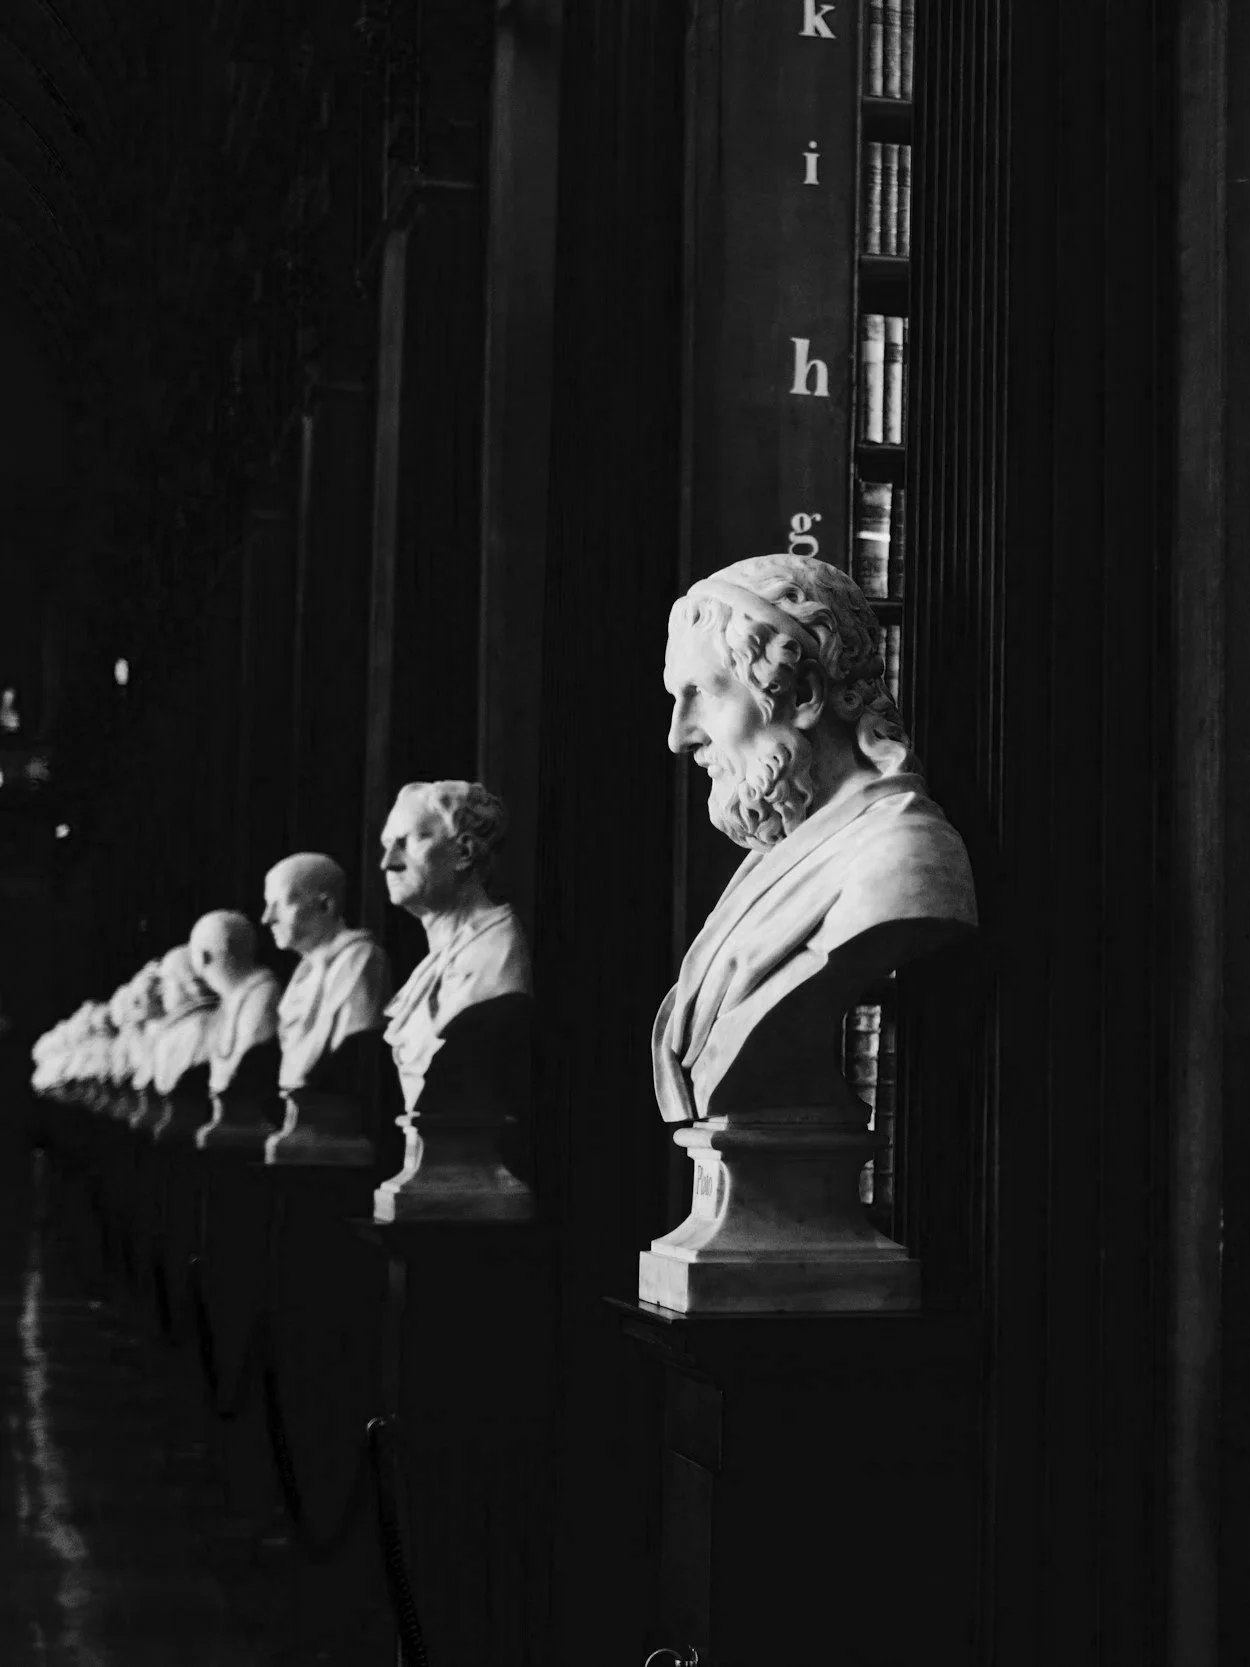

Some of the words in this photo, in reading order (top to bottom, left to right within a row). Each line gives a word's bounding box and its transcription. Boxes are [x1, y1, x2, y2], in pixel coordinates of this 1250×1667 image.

[799, 0, 836, 39] k
[803, 141, 820, 185] i
[789, 337, 830, 397] h
[785, 512, 822, 557] g
